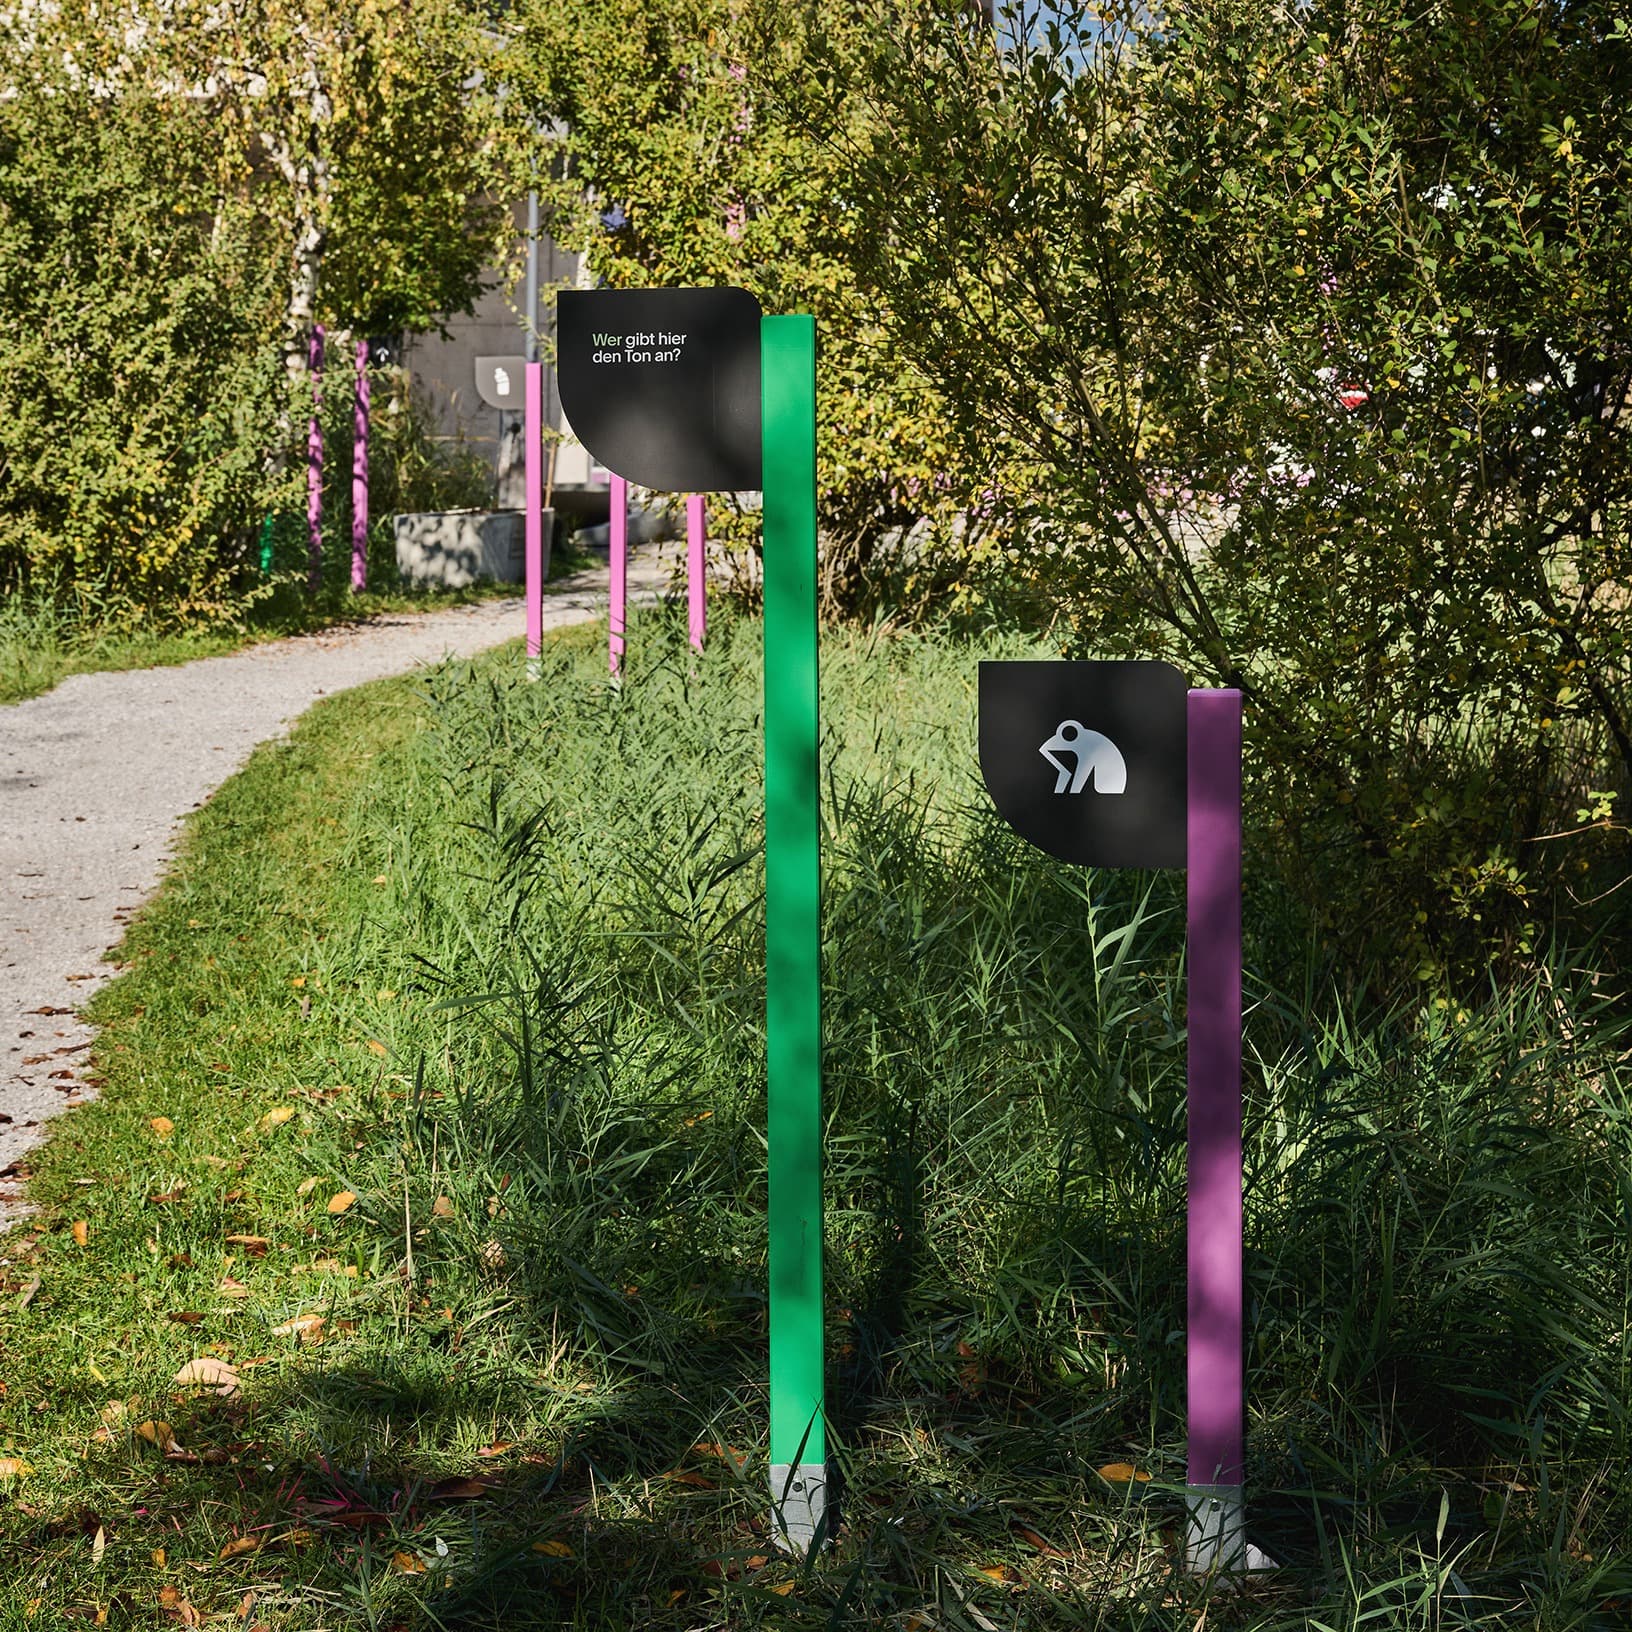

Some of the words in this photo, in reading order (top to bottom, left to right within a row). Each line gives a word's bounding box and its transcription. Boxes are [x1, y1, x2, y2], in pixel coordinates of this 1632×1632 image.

[592, 333, 622, 346] Wer
[625, 332, 655, 349] gibt
[658, 332, 687, 345] hier
[592, 350, 621, 363] den
[624, 349, 651, 362] Ton
[654, 348, 681, 362] an?
